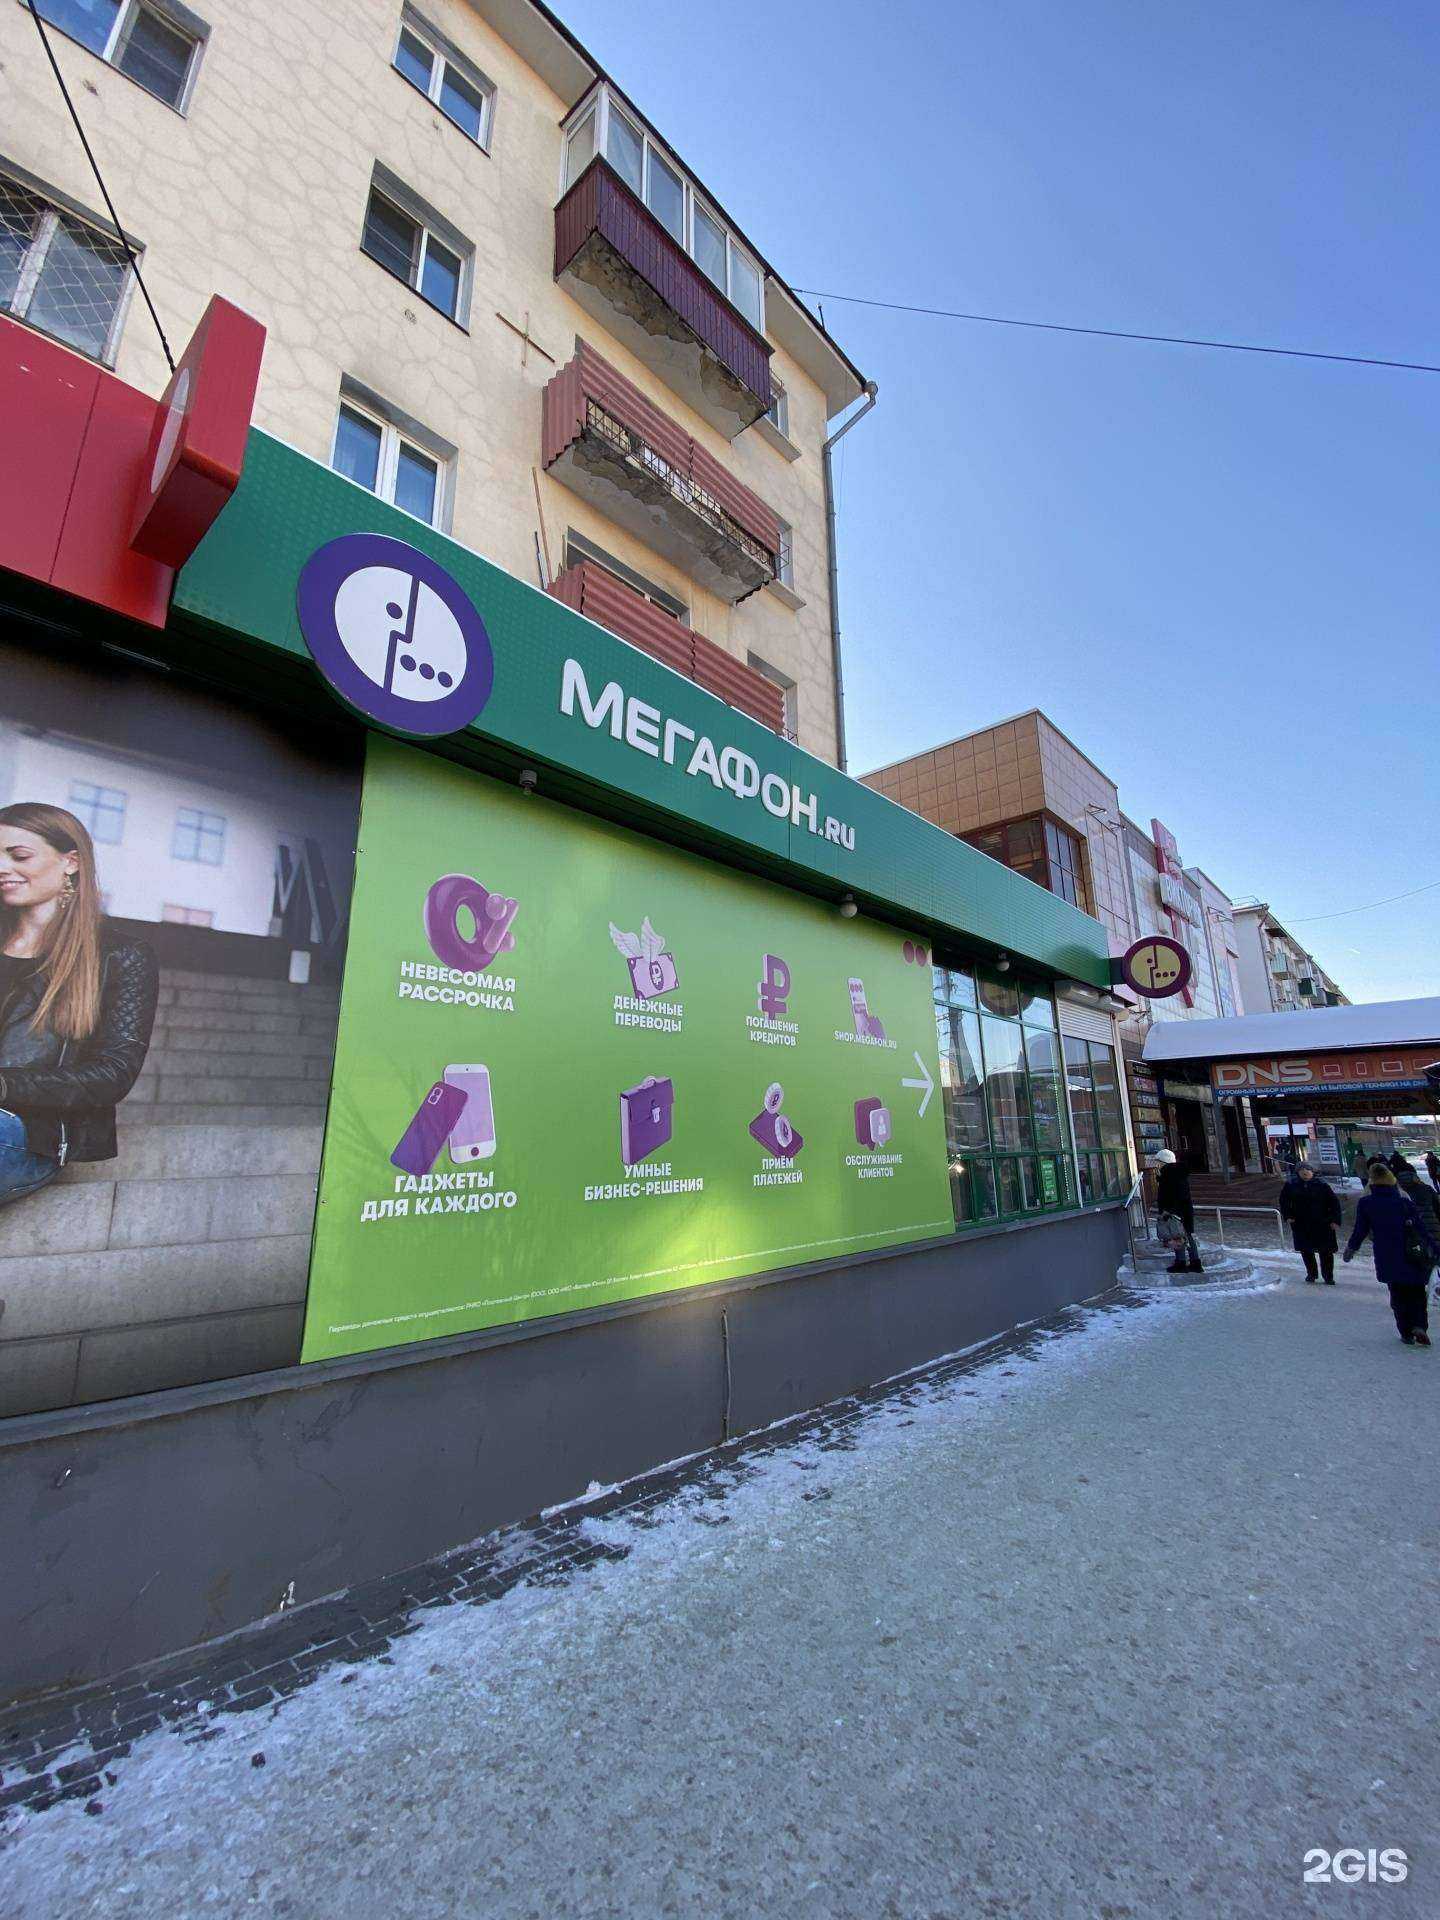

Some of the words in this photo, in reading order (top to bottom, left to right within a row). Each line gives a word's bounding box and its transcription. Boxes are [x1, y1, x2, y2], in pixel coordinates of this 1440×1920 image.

[400, 961, 517, 993] НЕВЕСОМАЯ
[398, 981, 515, 1012] РАССРОЧКА
[613, 994, 684, 1017] ДЕНЕЖНЫЕ
[614, 1011, 683, 1033] ПЕРЕВОДЫ
[746, 1015, 799, 1034] ПОГАШЕНИЕ
[750, 1030, 797, 1047] КРЕДИТОВ
[834, 1030, 898, 1049] SHOP.MEGAFON.RU
[1216, 1060, 1313, 1087] DNS
[624, 1163, 672, 1178] УМНЫЕ
[845, 1154, 903, 1166] ОБСЛУЖИВАНИЕ
[394, 1171, 495, 1193] ГАДЖЕТЫ
[753, 1170, 803, 1186] ПЛАТЕЖЕЙ
[858, 1167, 894, 1179] КЛИЕНТОВ
[584, 1178, 705, 1201] БИЗНЕС-РЕШЕНИЯ
[360, 1198, 408, 1223] ДЛЯ
[414, 1191, 518, 1216] КАЖДОГО
